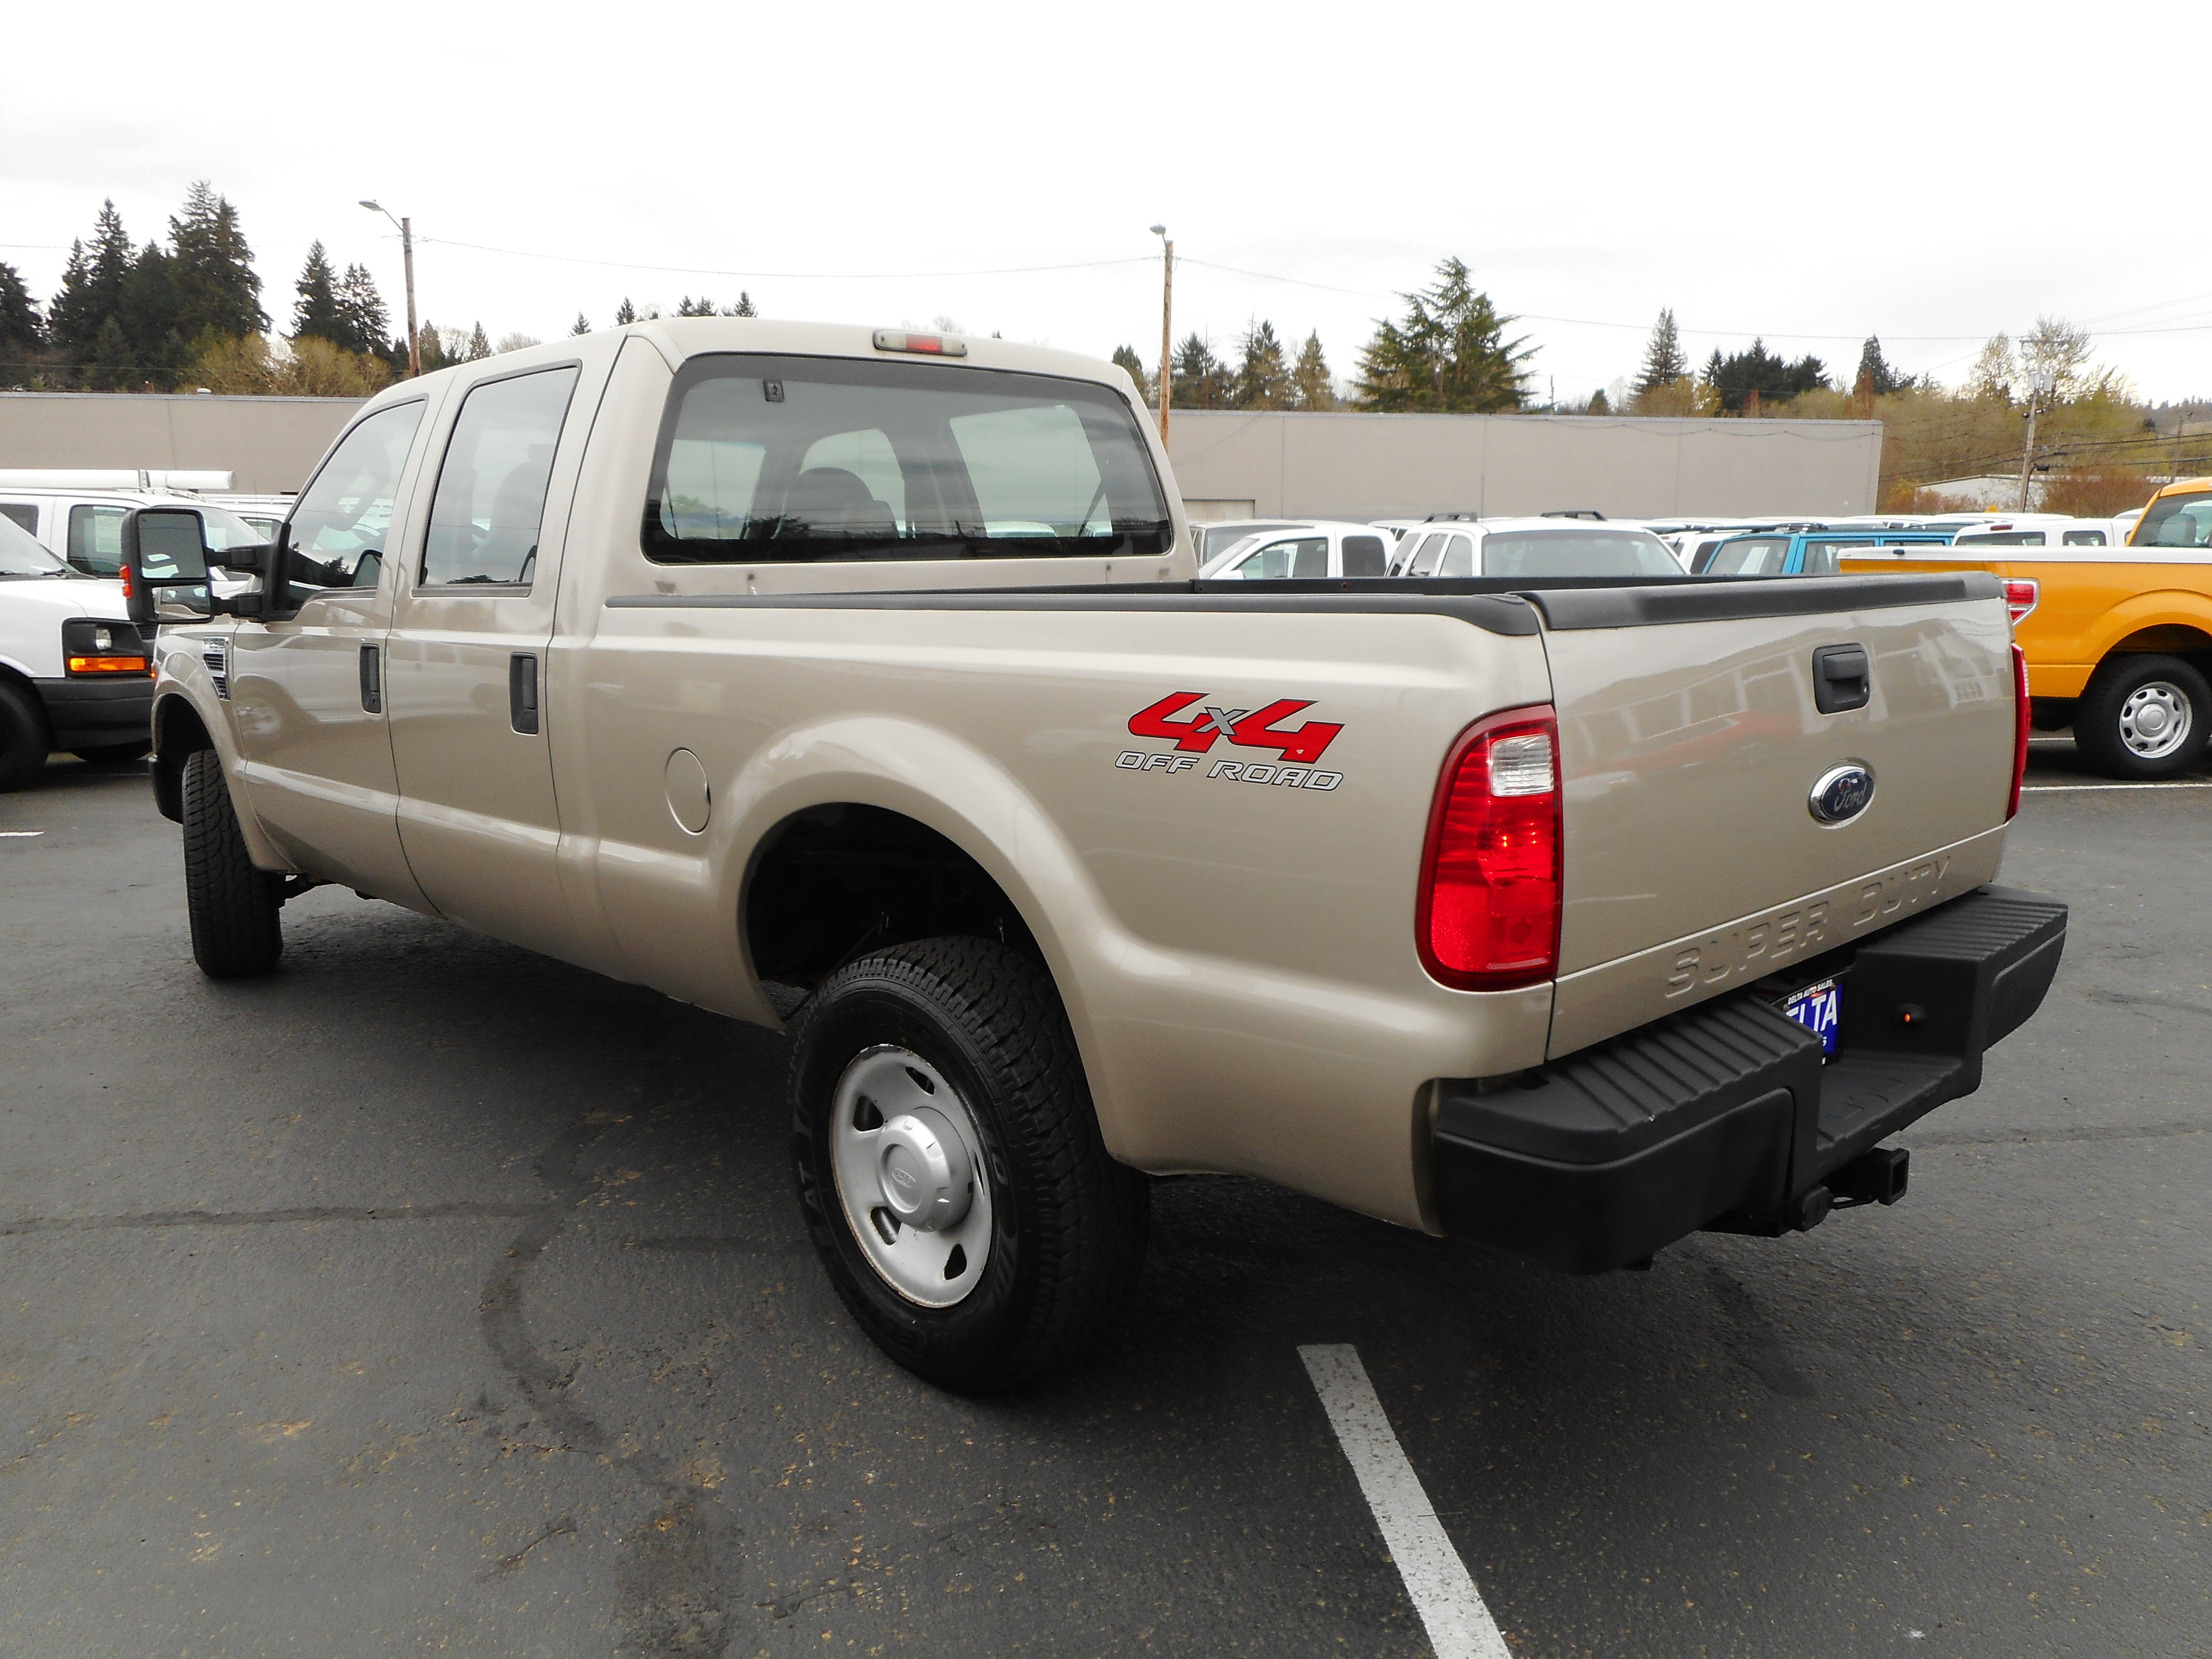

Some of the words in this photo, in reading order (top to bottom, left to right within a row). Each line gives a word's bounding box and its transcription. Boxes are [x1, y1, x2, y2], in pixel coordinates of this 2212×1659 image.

[1115, 750, 1200, 774] OFF
[1206, 760, 1344, 791] ROAD
[1834, 778, 1867, 811] Ford
[1665, 899, 1830, 999] SUPER
[1853, 856, 1951, 927] DUTY
[1787, 992, 1803, 1005] DELTA
[1803, 985, 1817, 998] AUTO
[1817, 979, 1833, 992] SALES
